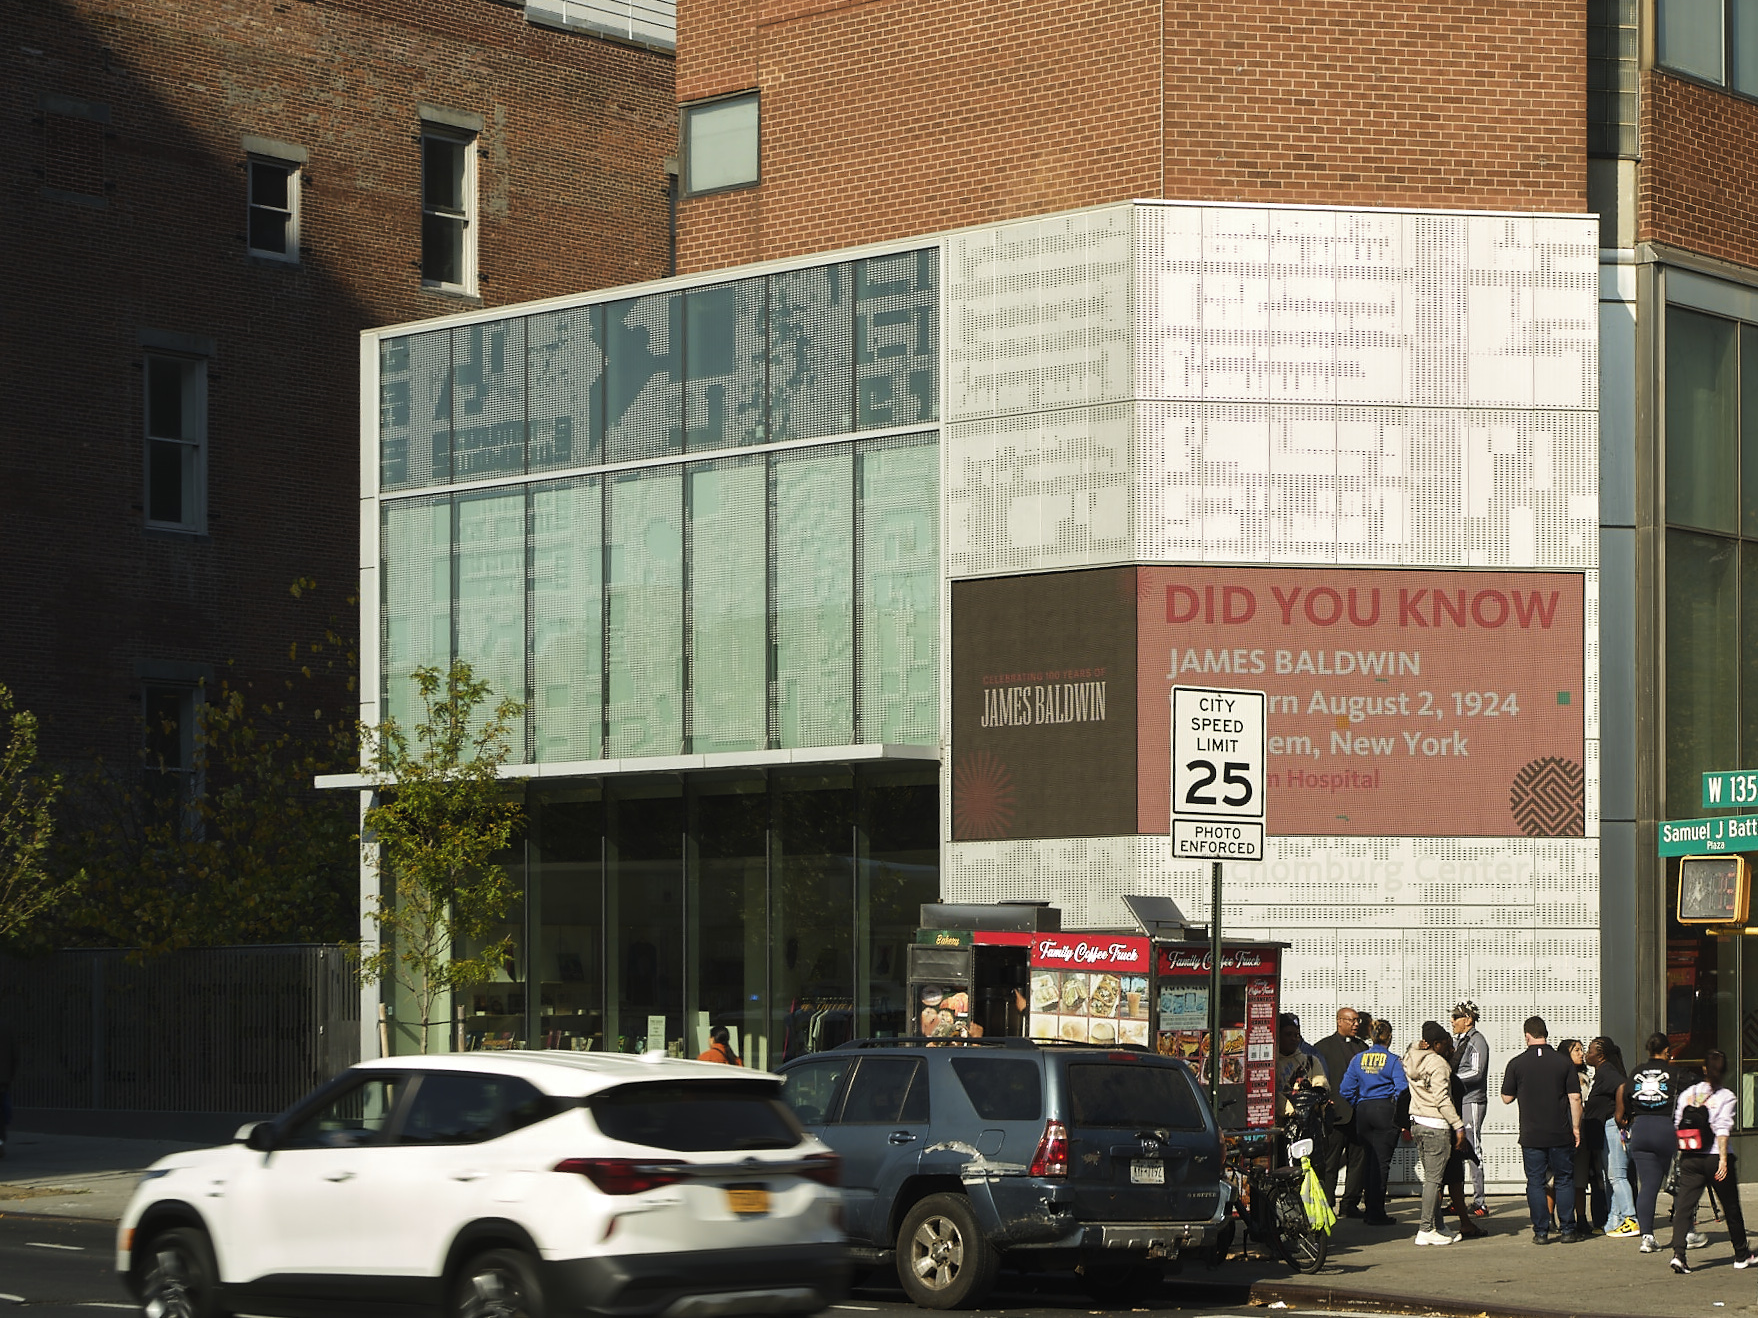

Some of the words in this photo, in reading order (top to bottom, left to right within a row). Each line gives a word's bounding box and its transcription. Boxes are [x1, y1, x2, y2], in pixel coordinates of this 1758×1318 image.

[1165, 584, 1257, 625] DID
[1271, 585, 1380, 627] YOU
[1400, 588, 1560, 630] KNOW
[1166, 648, 1266, 680] JAMES
[1275, 650, 1420, 677] BALDWIN
[982, 671, 1043, 685] CELEBRATING
[1045, 670, 1060, 681] 100
[1063, 668, 1091, 679] YEARS
[1094, 667, 1106, 678] OF
[981, 685, 1032, 728] JAMES
[1034, 681, 1106, 725] BALDWIN
[1199, 697, 1235, 713] CITY
[1306, 690, 1410, 723] August
[1417, 691, 1444, 721] 2,
[1451, 691, 1520, 717] 1924
[1191, 717, 1244, 733] SPEED
[1197, 737, 1239, 753] LIMIT
[1330, 731, 1395, 757] New
[1403, 729, 1469, 757] York
[1186, 759, 1253, 806] 25
[1288, 769, 1379, 794] Hospital
[1708, 777, 1722, 803] W
[1730, 775, 1757, 803] 135
[1194, 826, 1241, 841] PHOTO
[1663, 822, 1711, 843] Samuel
[1715, 821, 1724, 839] J
[1180, 839, 1255, 855] ENFORCED
[1706, 840, 1725, 850] Plaza
[1415, 854, 1531, 883] Center
[935, 934, 961, 947] Bakery
[1039, 940, 1074, 962] Family
[1073, 941, 1108, 963] Coffee
[1108, 942, 1139, 963] Truck
[1168, 950, 1201, 970] Family
[1235, 950, 1262, 969] Truck
[1360, 1052, 1387, 1067] NYPD
